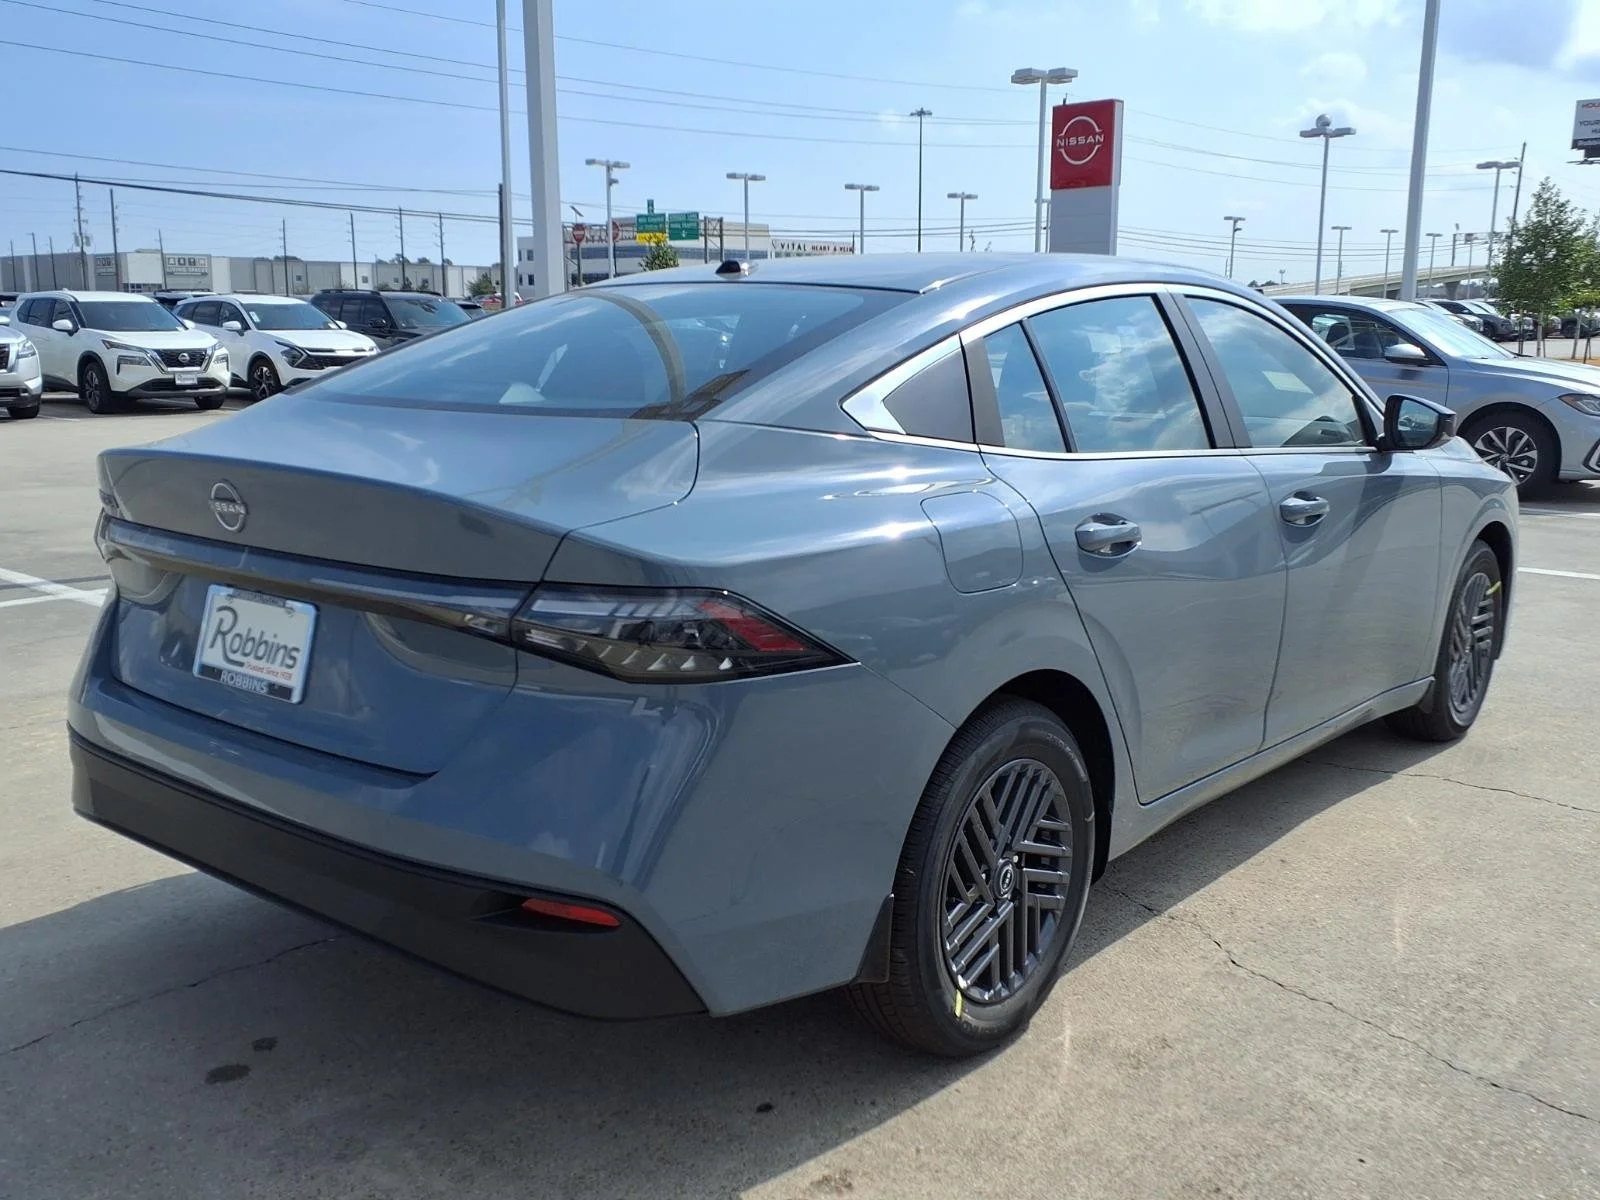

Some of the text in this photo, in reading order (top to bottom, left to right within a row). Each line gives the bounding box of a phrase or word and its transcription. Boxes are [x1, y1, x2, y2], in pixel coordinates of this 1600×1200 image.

[1057, 134, 1104, 147] NISSAN
[781, 242, 806, 251] VITAL
[208, 605, 300, 669] Robbins
[220, 670, 267, 693] ROBBINS
